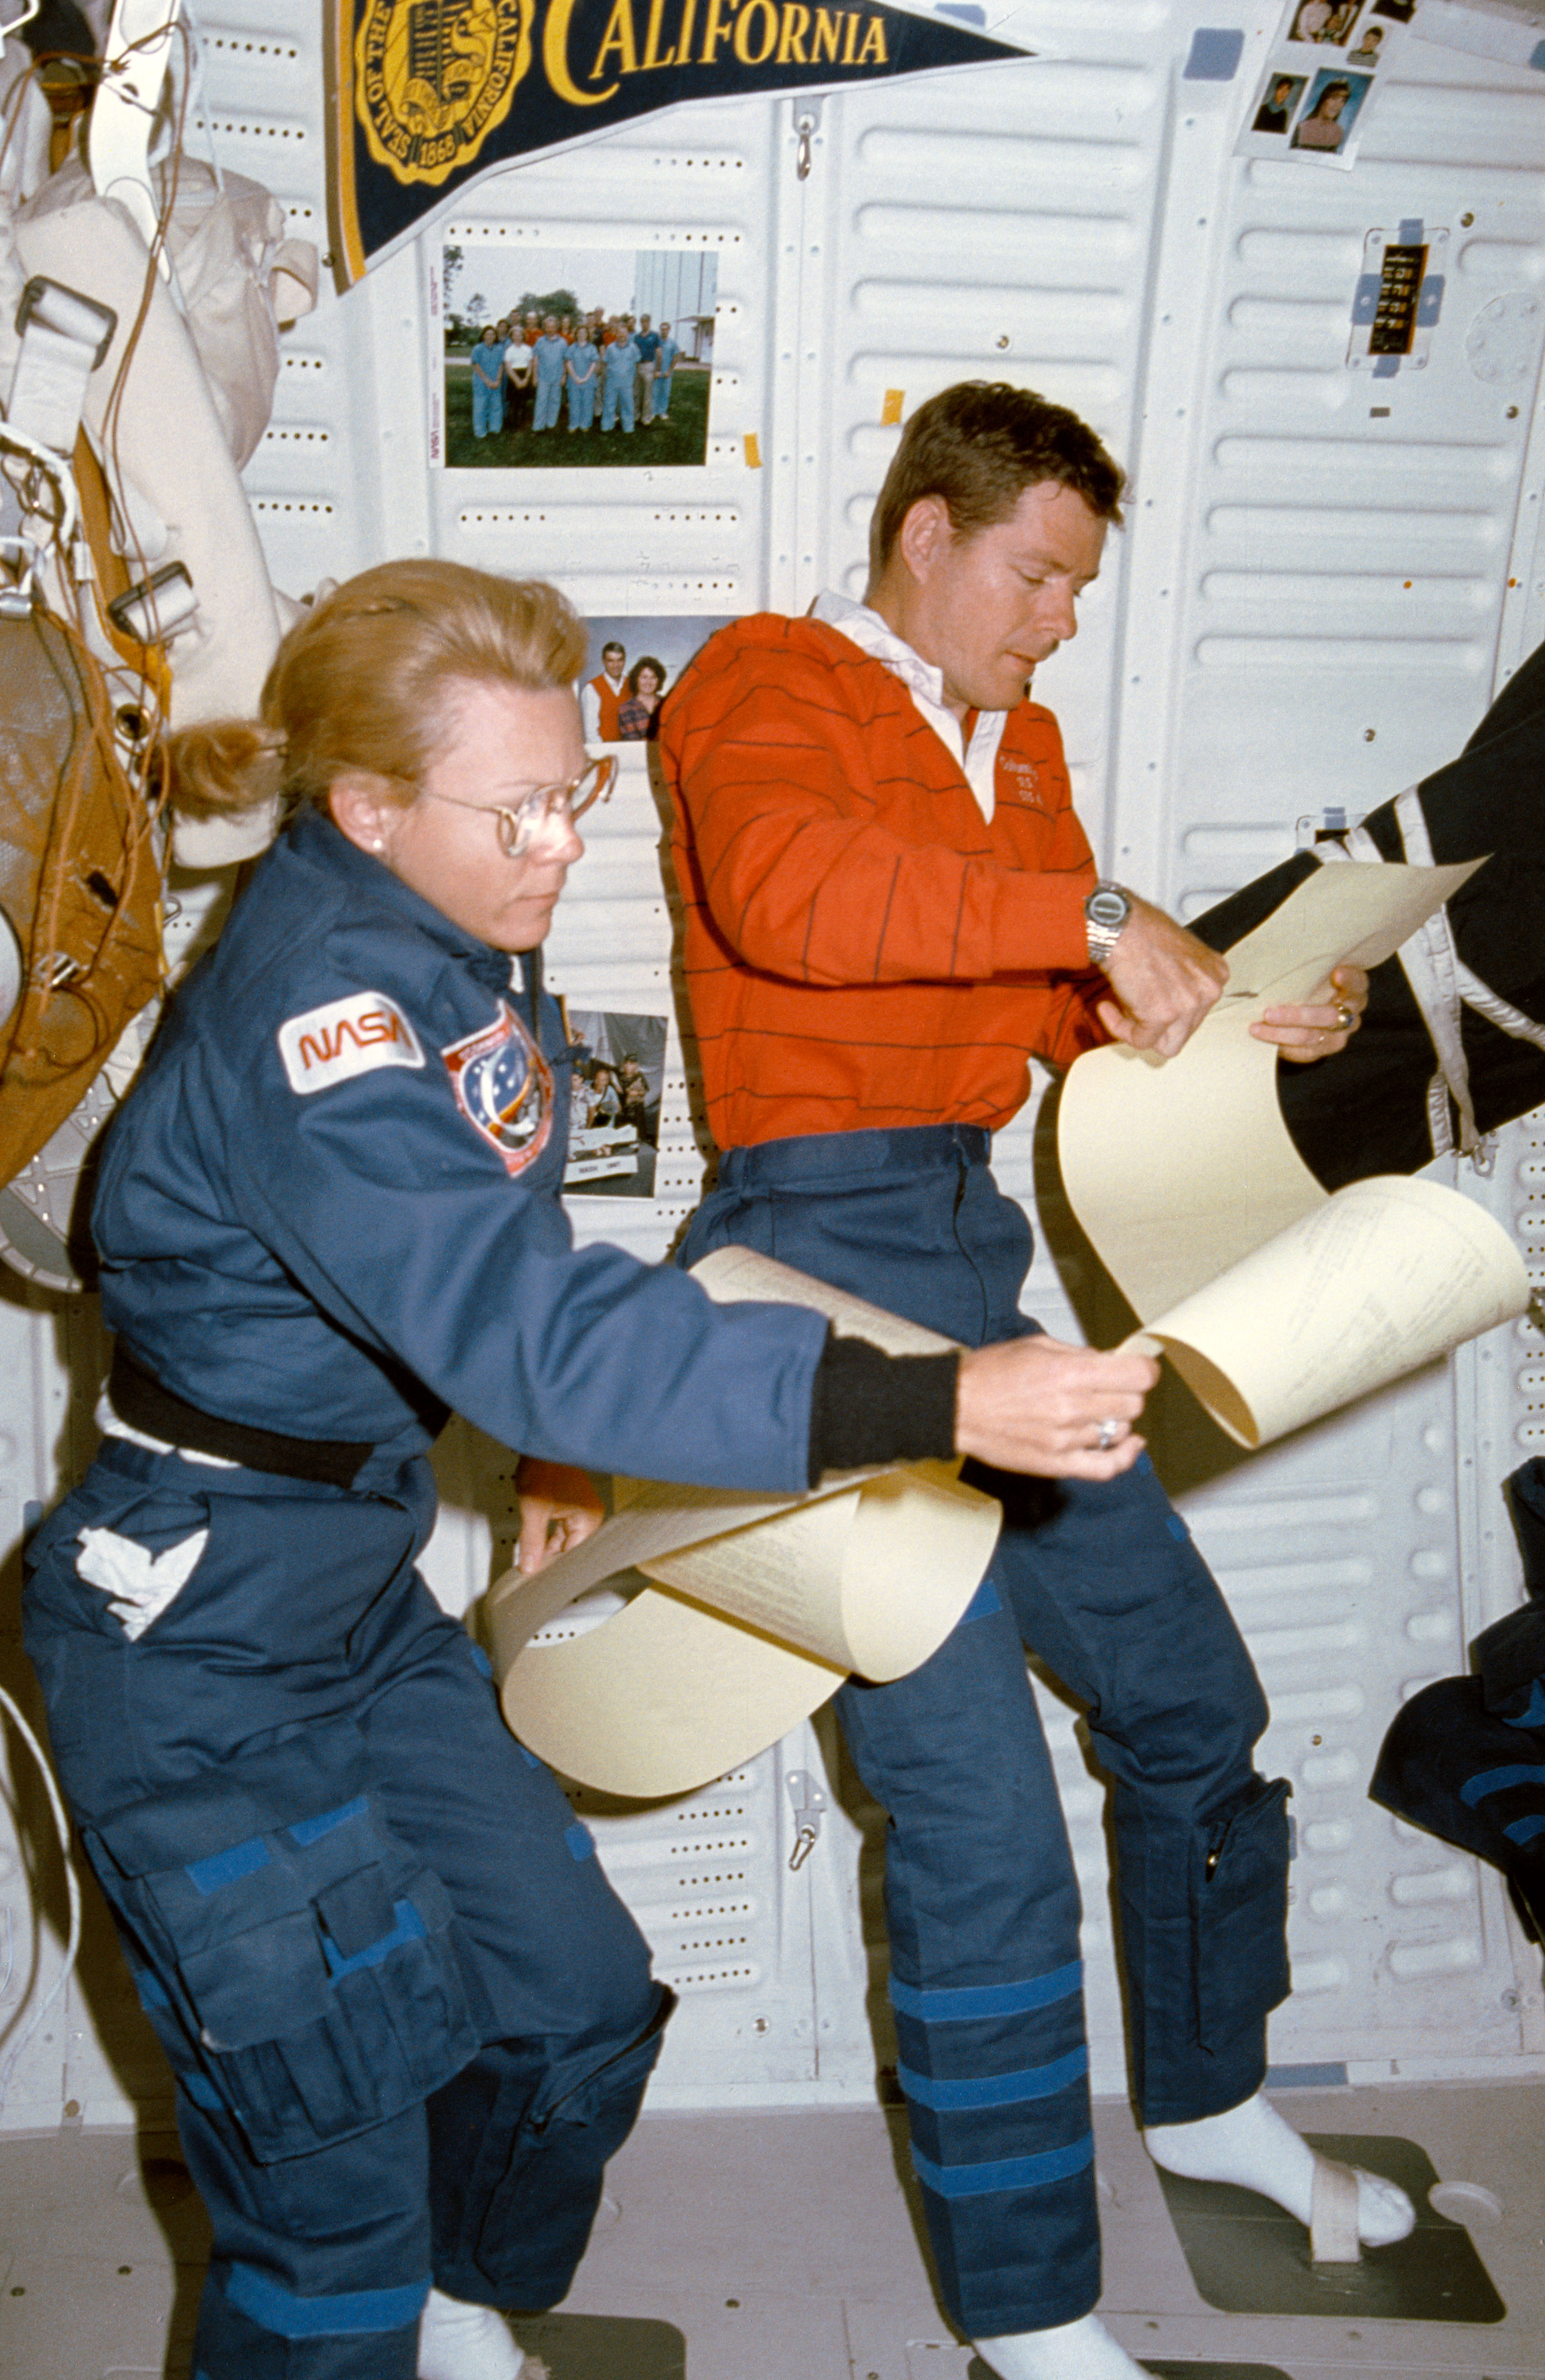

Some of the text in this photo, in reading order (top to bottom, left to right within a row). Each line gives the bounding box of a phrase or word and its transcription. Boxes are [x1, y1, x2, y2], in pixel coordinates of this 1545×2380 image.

[366, 0, 412, 158] SEAL OF THE
[461, 0, 518, 137] CALIFORNIA
[543, 0, 889, 106] CALIFORNIA
[420, 134, 455, 165] 1868
[299, 1011, 412, 1069] NASA
